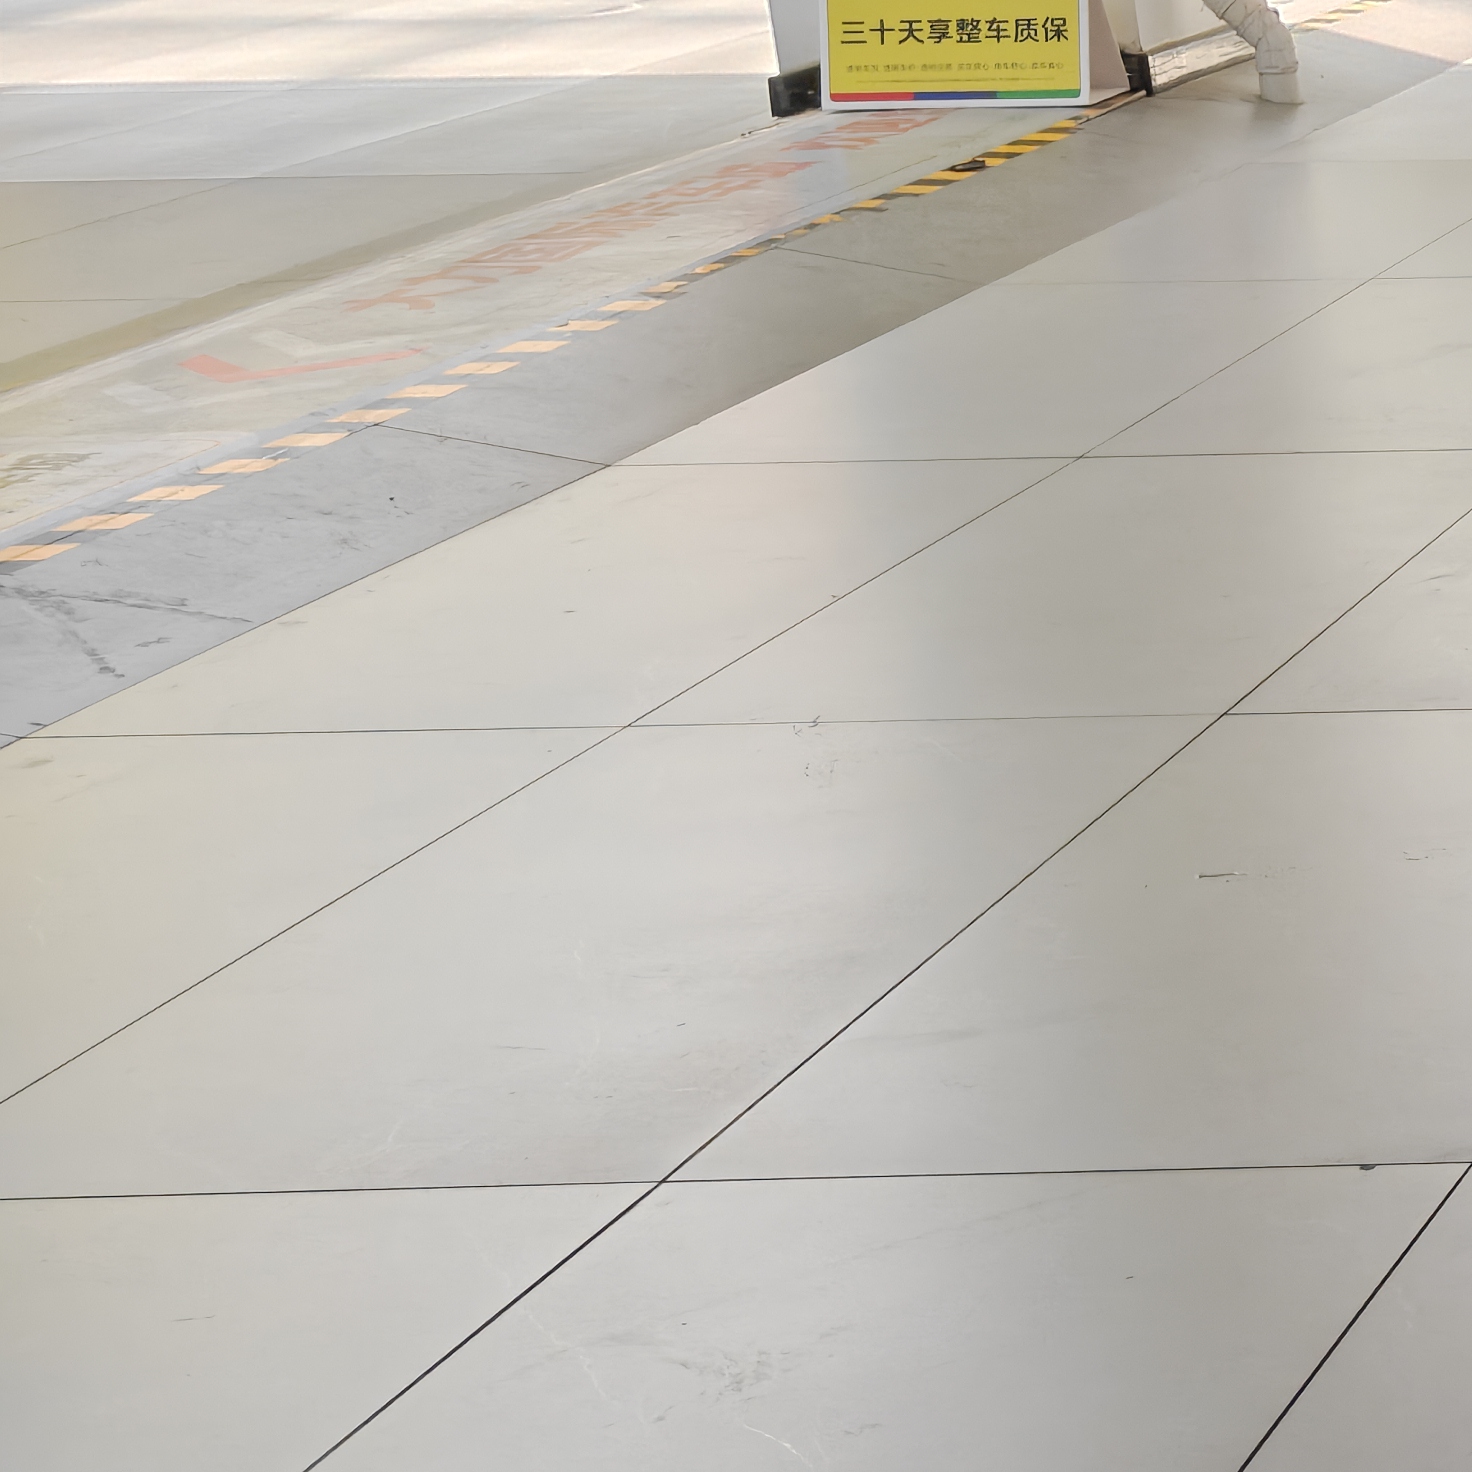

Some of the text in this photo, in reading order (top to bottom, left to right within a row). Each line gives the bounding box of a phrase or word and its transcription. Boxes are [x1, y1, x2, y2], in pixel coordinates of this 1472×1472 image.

[840, 17, 1070, 46] 三十天享整车质保
